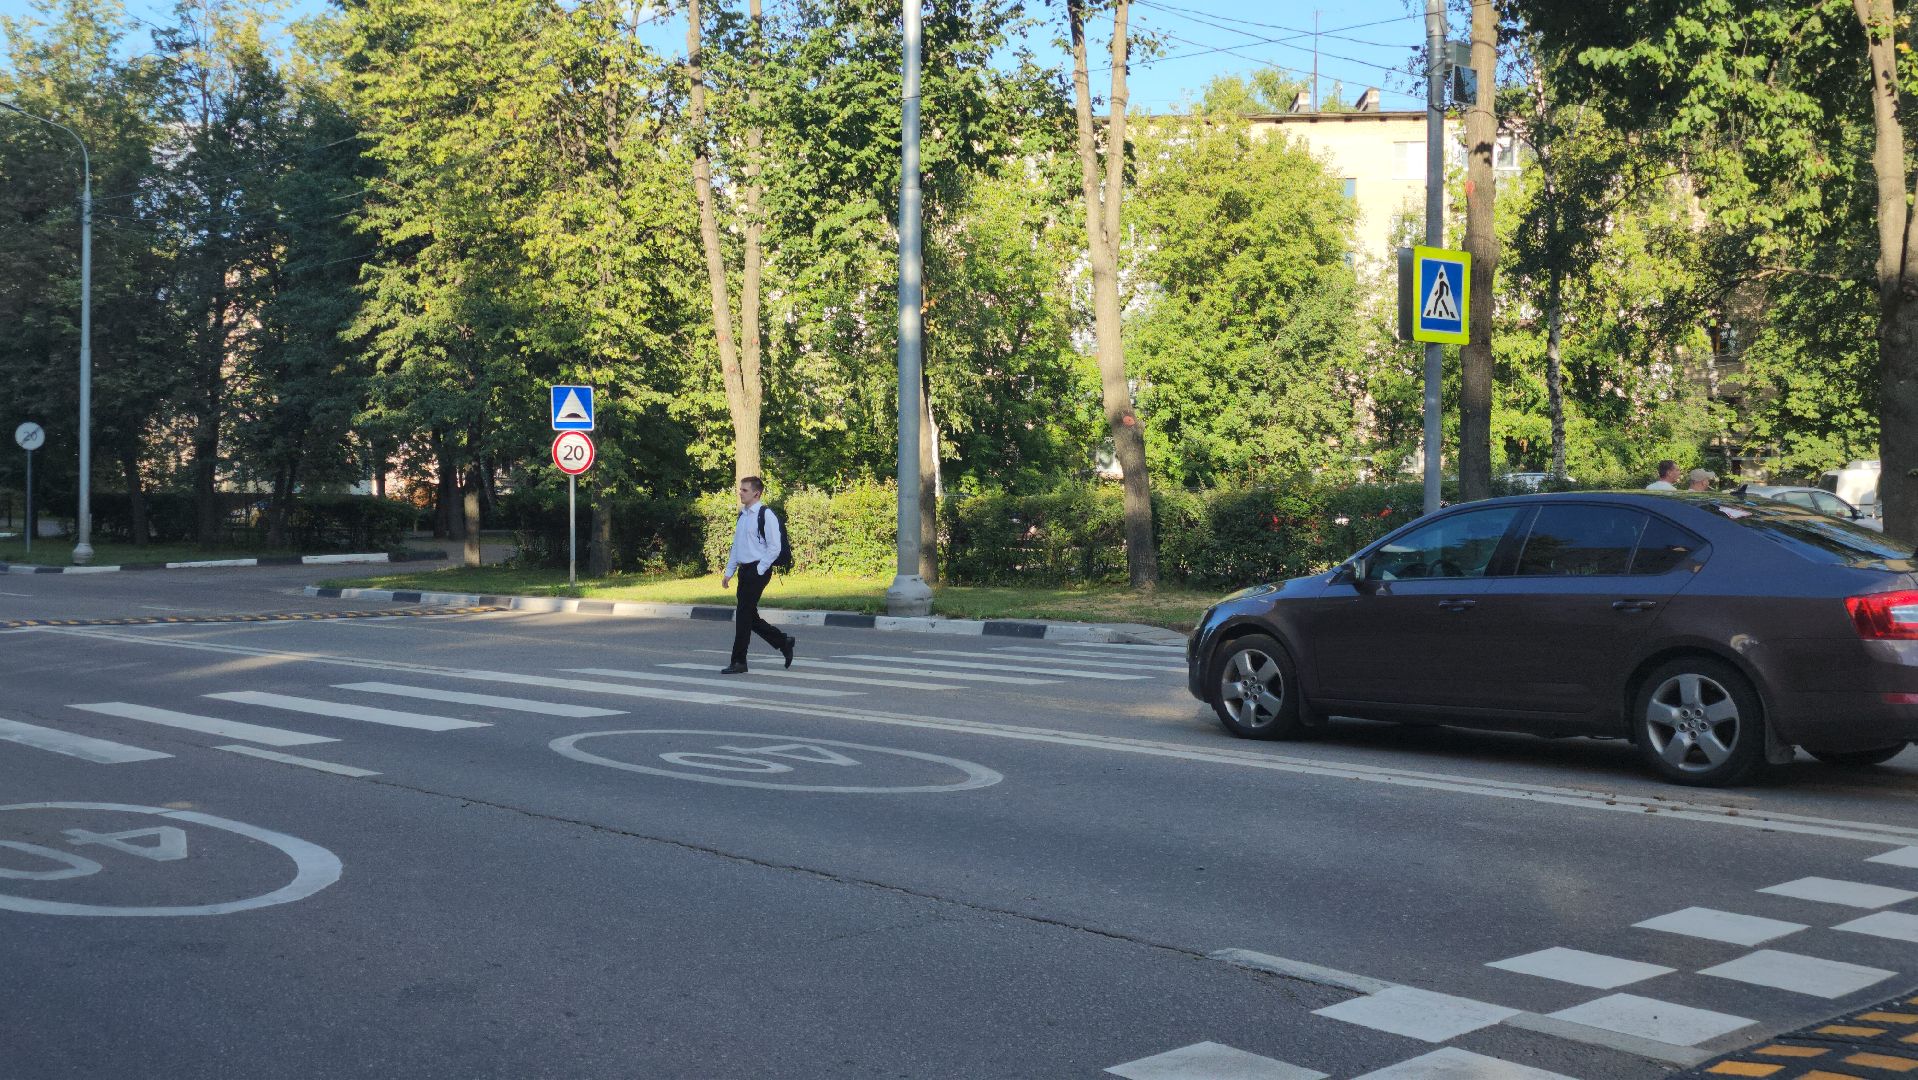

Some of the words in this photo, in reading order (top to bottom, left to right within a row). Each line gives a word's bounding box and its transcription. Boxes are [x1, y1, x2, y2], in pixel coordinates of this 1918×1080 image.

[24, 431, 38, 442] 20
[563, 444, 585, 461] 20
[658, 743, 862, 774] 40
